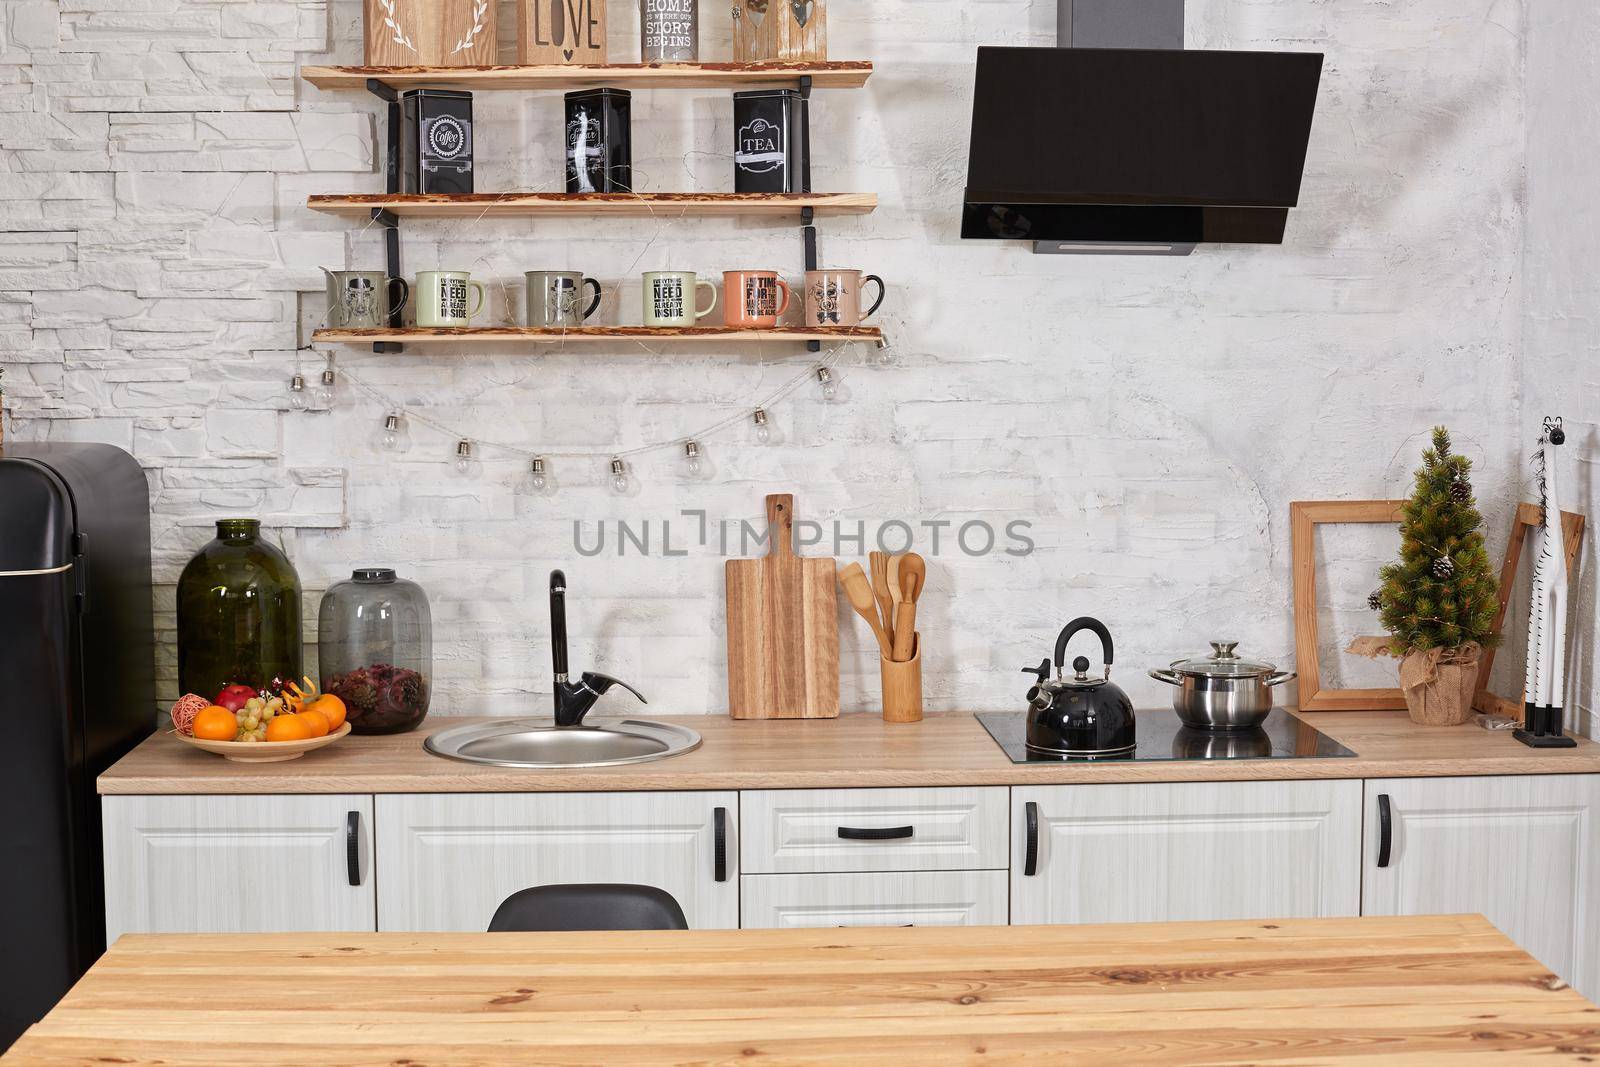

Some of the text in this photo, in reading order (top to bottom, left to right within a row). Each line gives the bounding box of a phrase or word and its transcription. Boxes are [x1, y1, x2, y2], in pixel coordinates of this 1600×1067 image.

[646, 0, 692, 12] HOME
[534, 0, 601, 49] LOVE
[646, 21, 692, 35] STORY
[646, 36, 692, 47] BEGINS
[435, 130, 459, 146] Coffee
[743, 138, 776, 151] TEA
[440, 286, 467, 300] NEED
[653, 286, 682, 299] NEED
[746, 287, 768, 300] FOR
[654, 301, 683, 309] ALREADY
[654, 307, 684, 318] INSIDE
